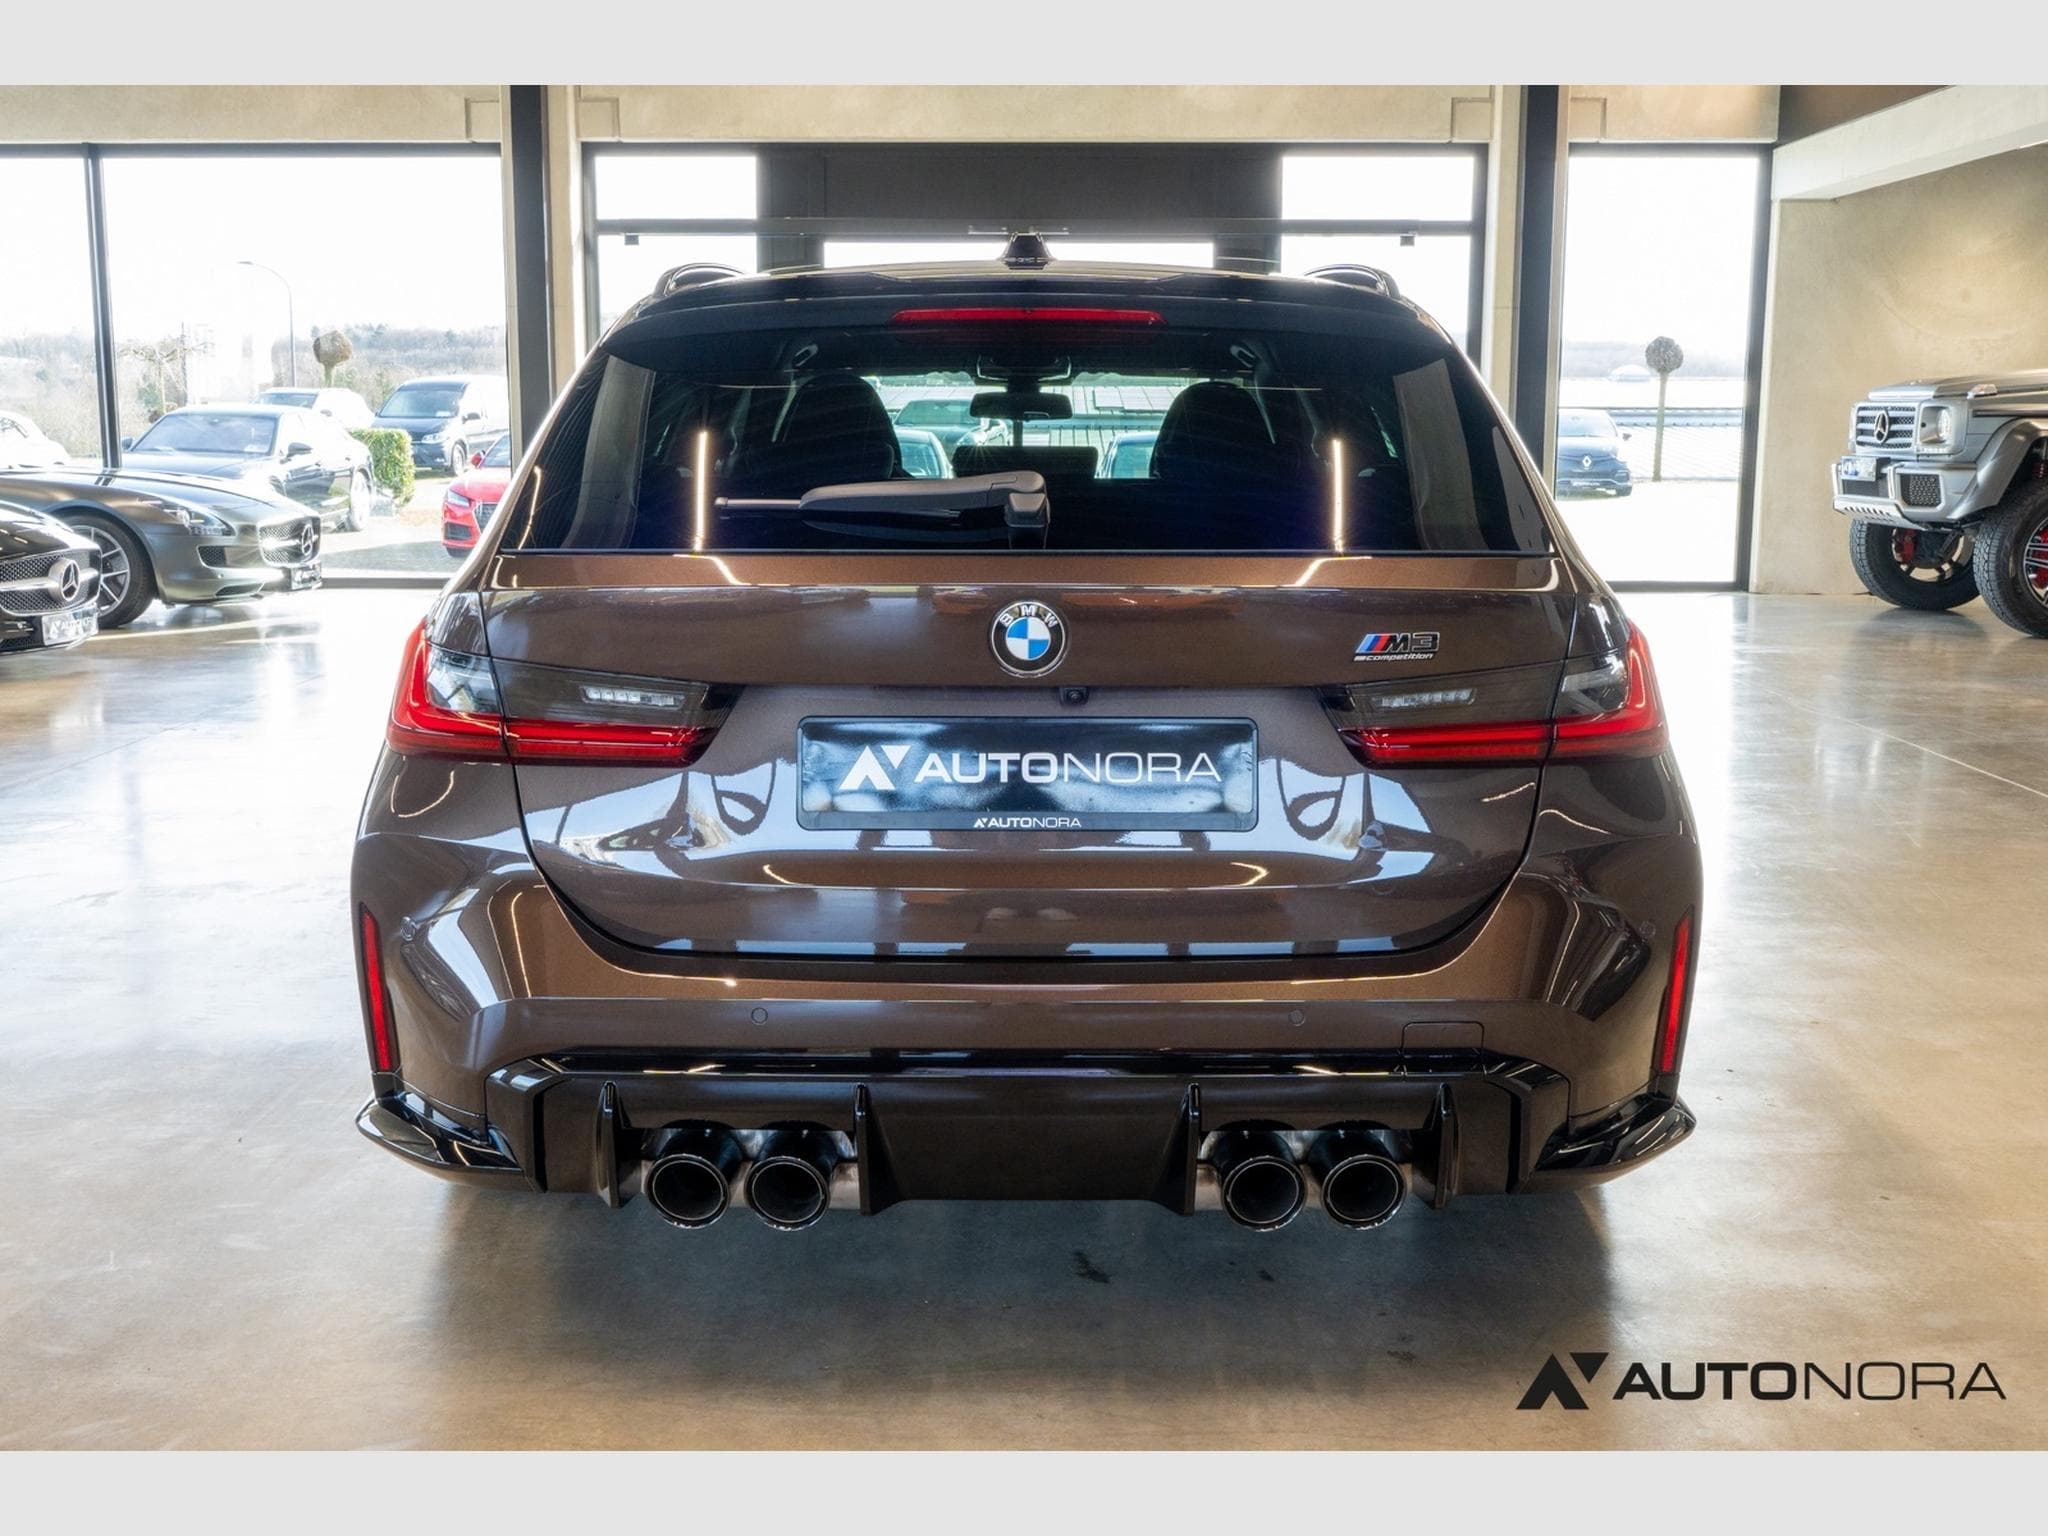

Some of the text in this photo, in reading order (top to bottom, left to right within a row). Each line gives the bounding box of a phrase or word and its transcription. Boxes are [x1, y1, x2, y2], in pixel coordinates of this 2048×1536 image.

[1000, 605, 1059, 628] BMW
[1366, 653, 1434, 662] competition
[914, 752, 1222, 783] AUTONORA
[987, 817, 1082, 828] AUTONORA
